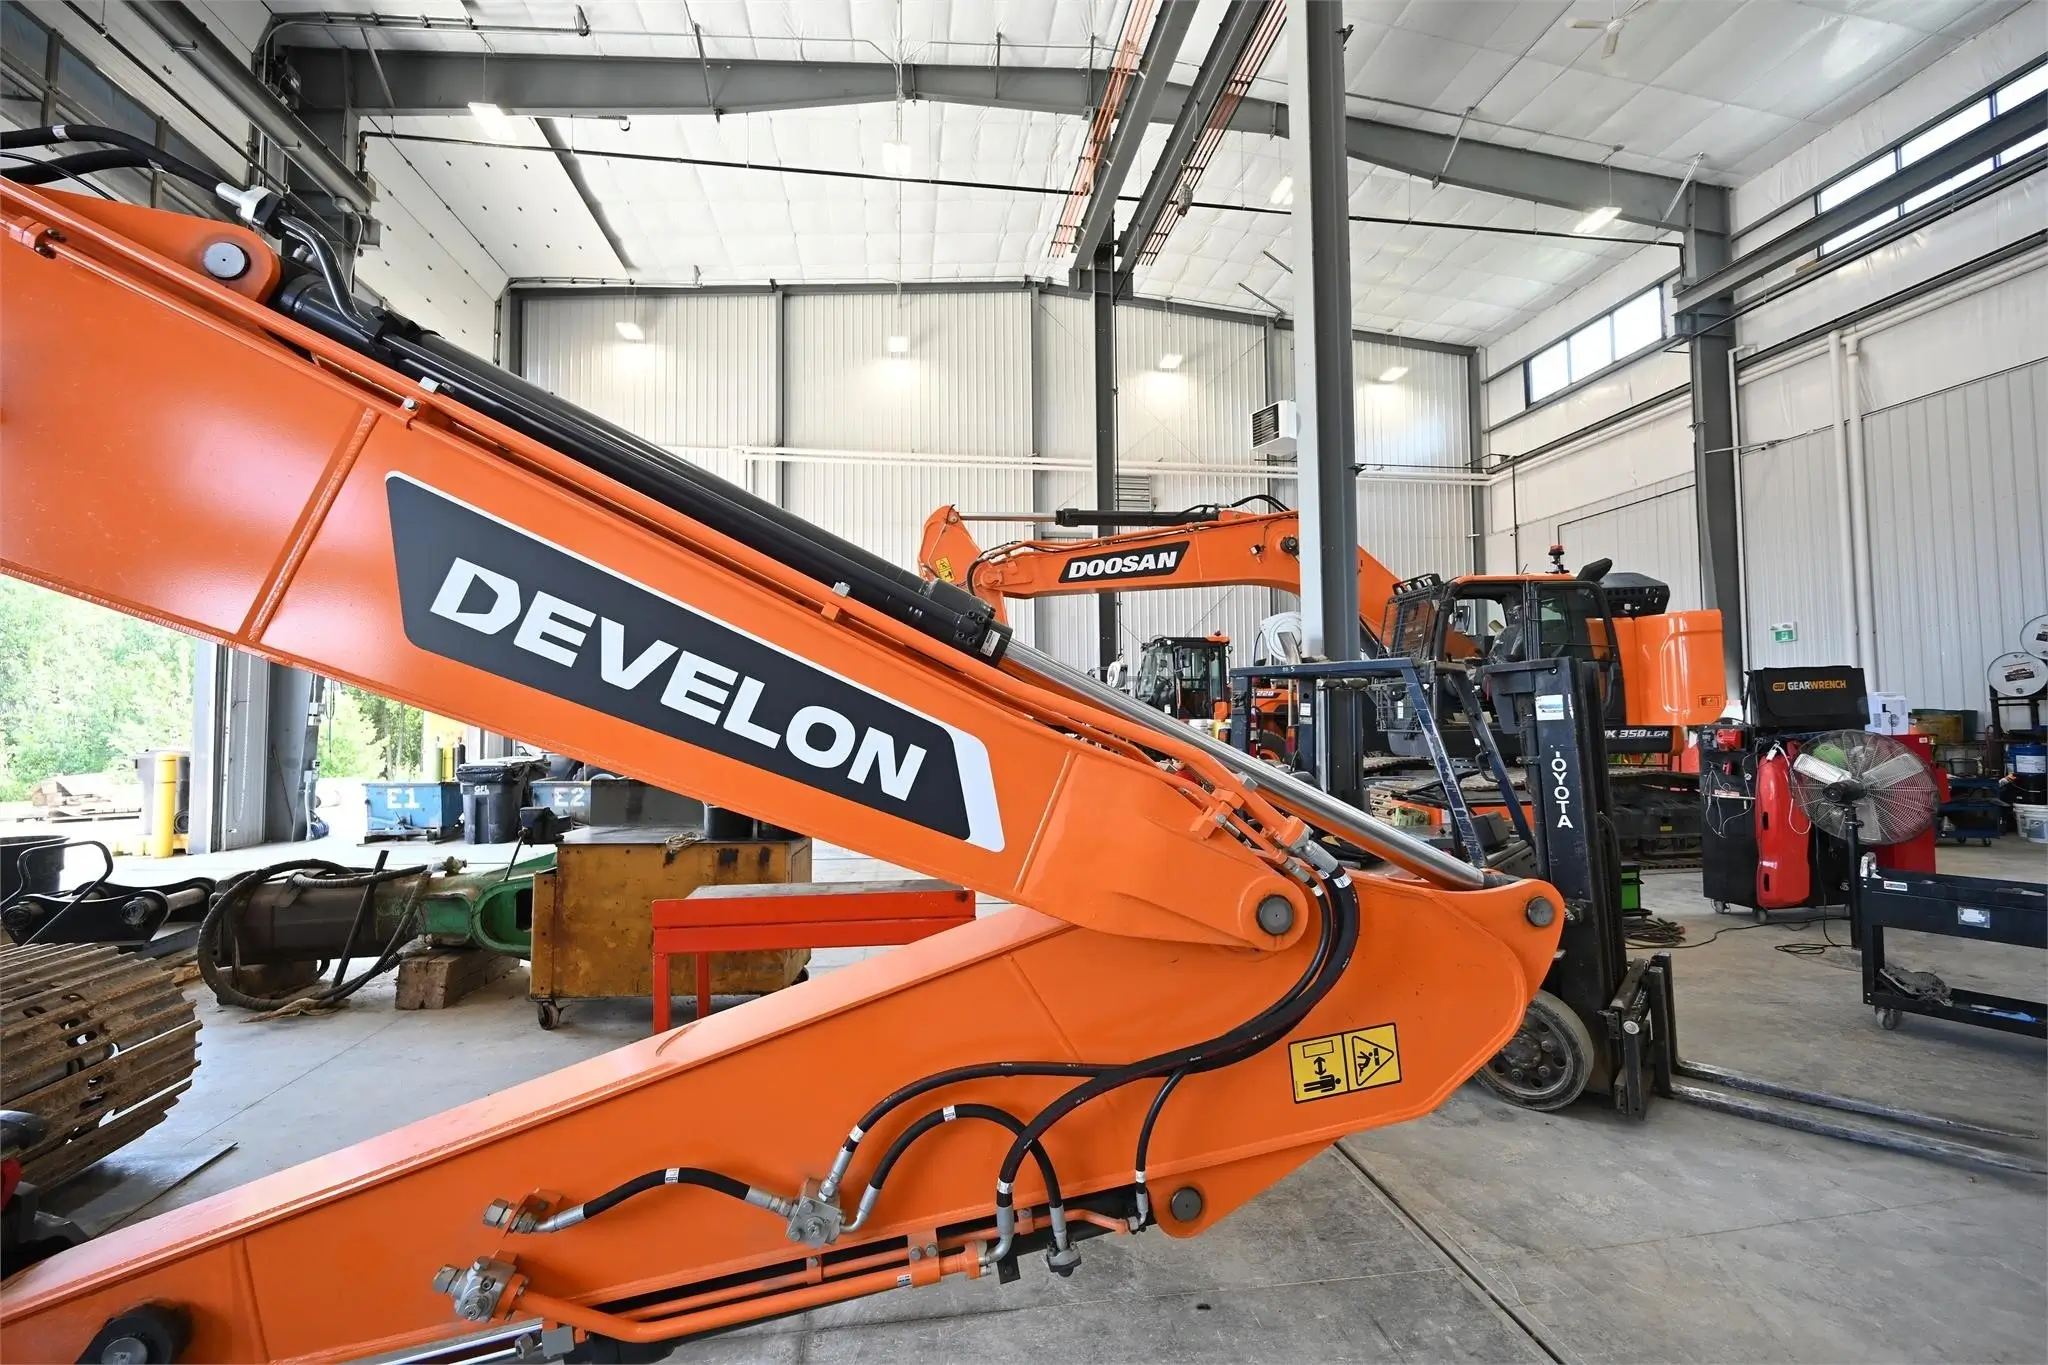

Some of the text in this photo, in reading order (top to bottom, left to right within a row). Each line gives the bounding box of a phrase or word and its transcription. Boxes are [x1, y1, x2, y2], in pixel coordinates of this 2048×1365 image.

[1068, 551, 1177, 578] DOOSAN
[430, 556, 927, 802] DEVELON
[1787, 680, 1847, 691] GEARWRENCH
[386, 788, 420, 809] E1
[474, 785, 488, 793] GFL
[554, 787, 585, 807] E2
